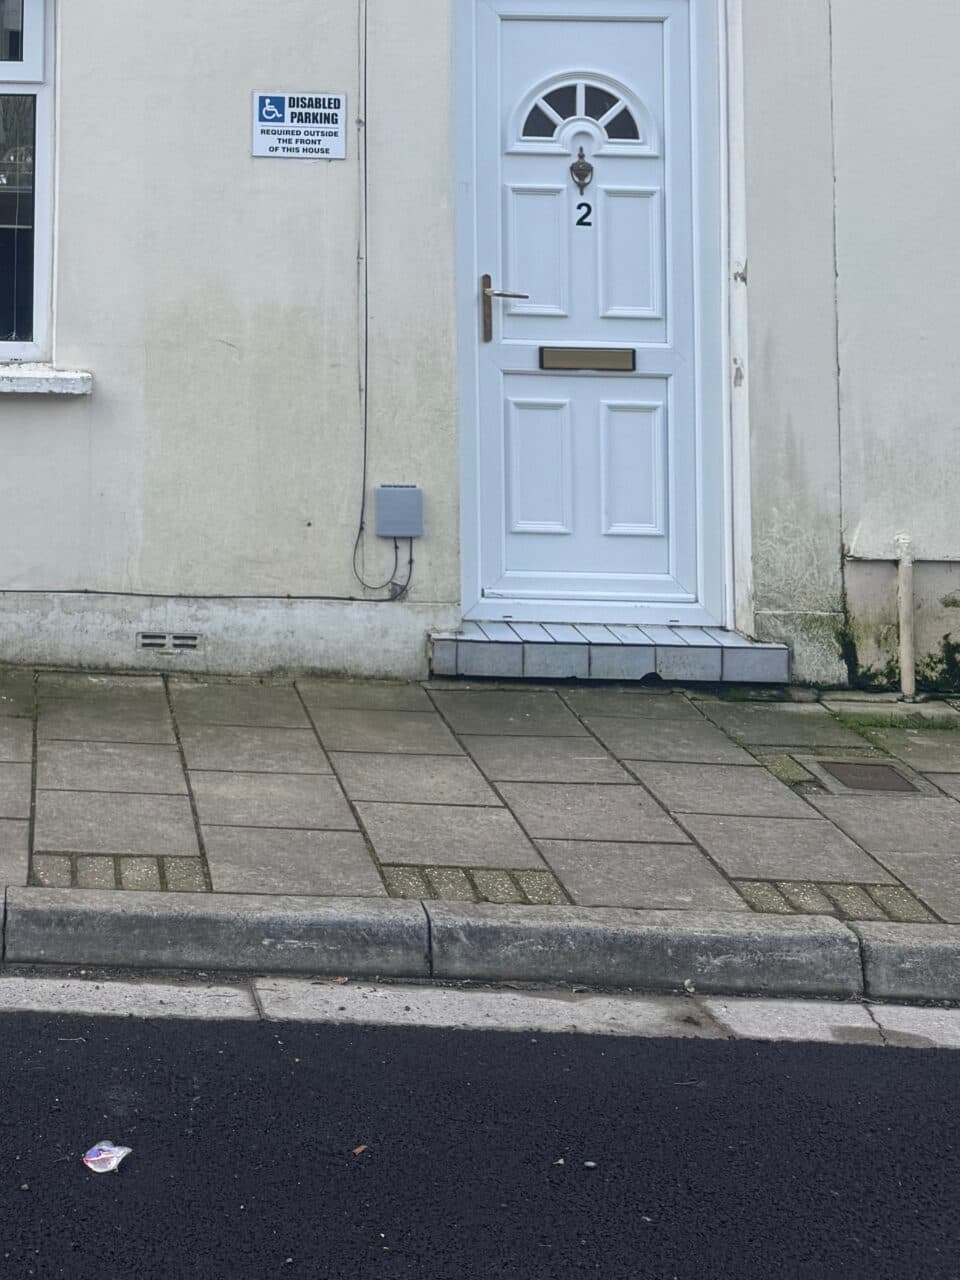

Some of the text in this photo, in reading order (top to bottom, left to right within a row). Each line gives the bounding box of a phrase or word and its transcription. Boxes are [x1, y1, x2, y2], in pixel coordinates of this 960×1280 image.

[288, 96, 341, 110] DISABLED
[290, 111, 339, 125] PARKING
[260, 128, 301, 136] REQUIRED
[575, 202, 592, 227] 2
